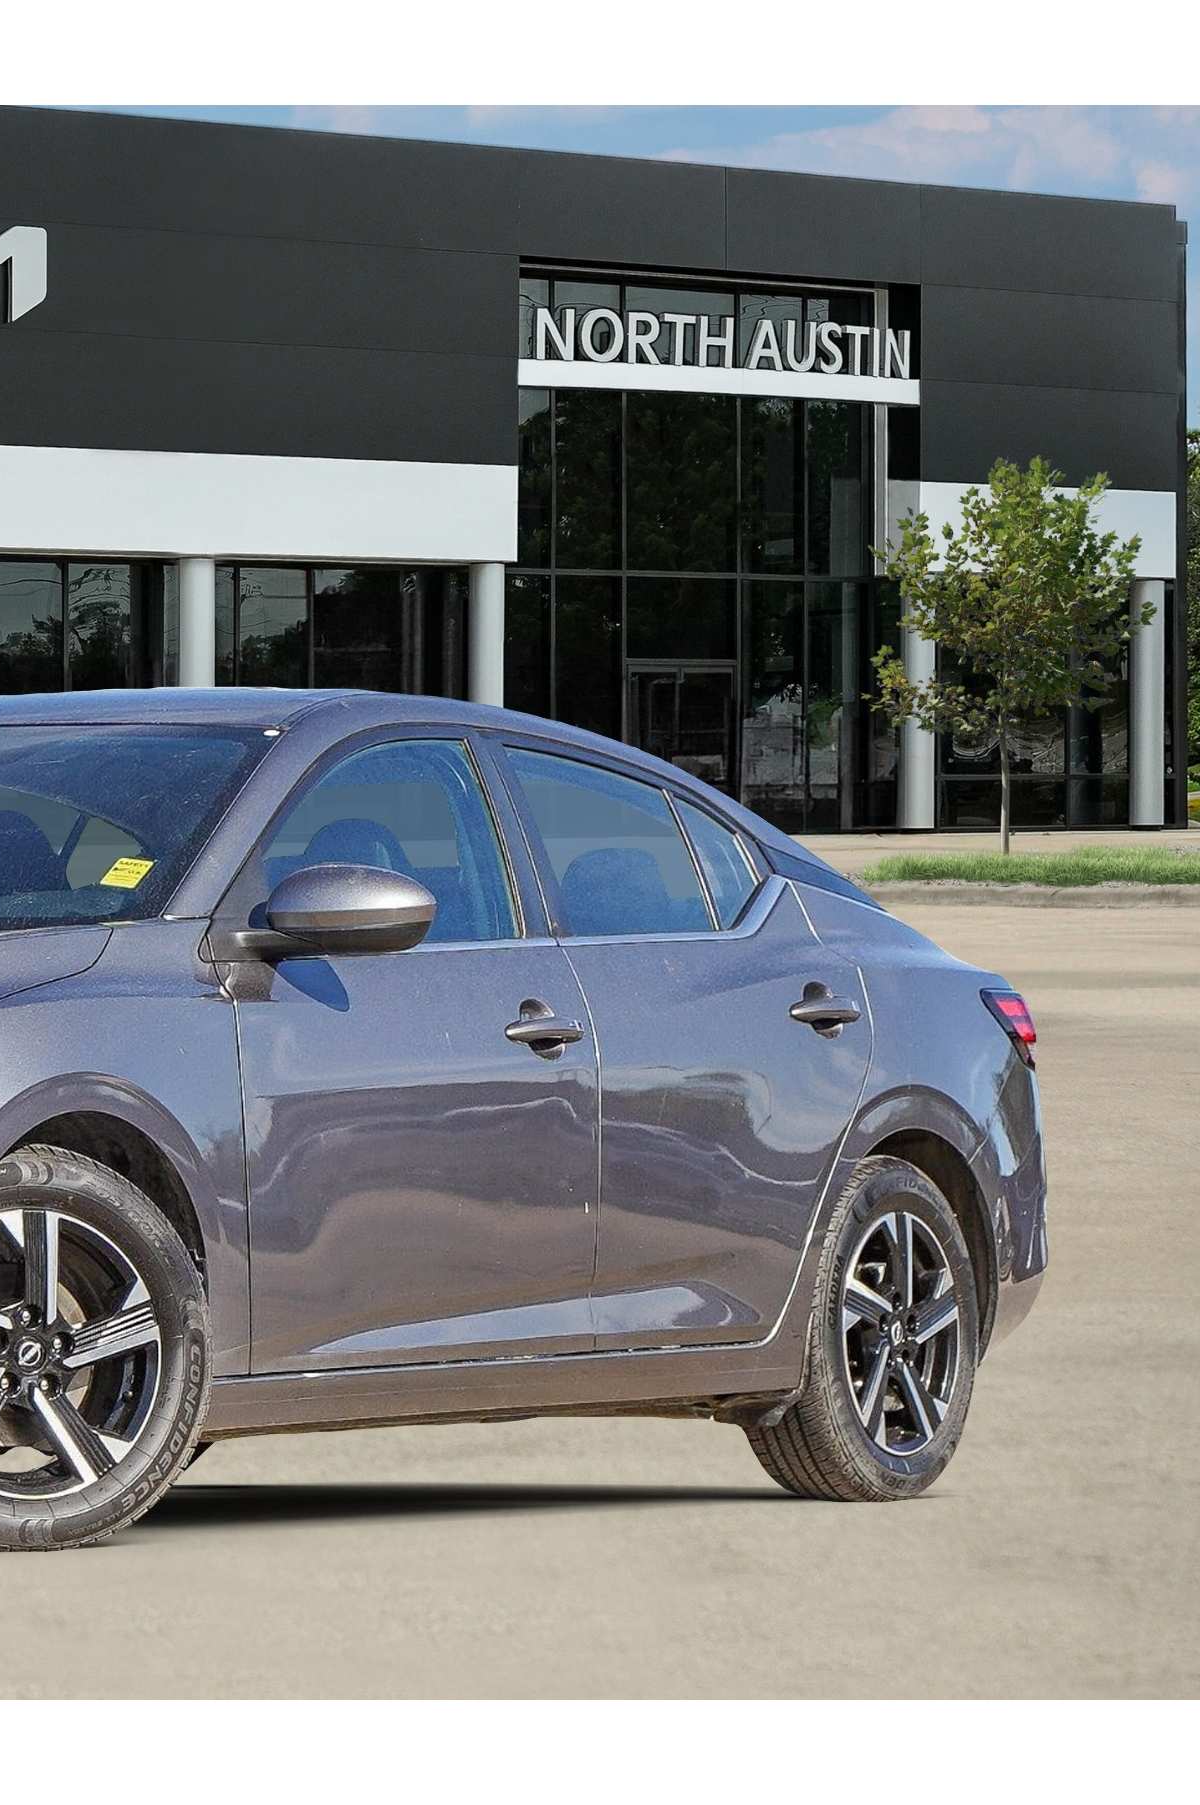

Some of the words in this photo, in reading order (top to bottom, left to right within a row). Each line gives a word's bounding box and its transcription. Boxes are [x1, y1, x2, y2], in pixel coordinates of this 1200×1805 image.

[535, 307, 735, 369] NORTH
[748, 318, 911, 380] AUSTIN
[120, 1343, 204, 1514] CONFIDENCE
